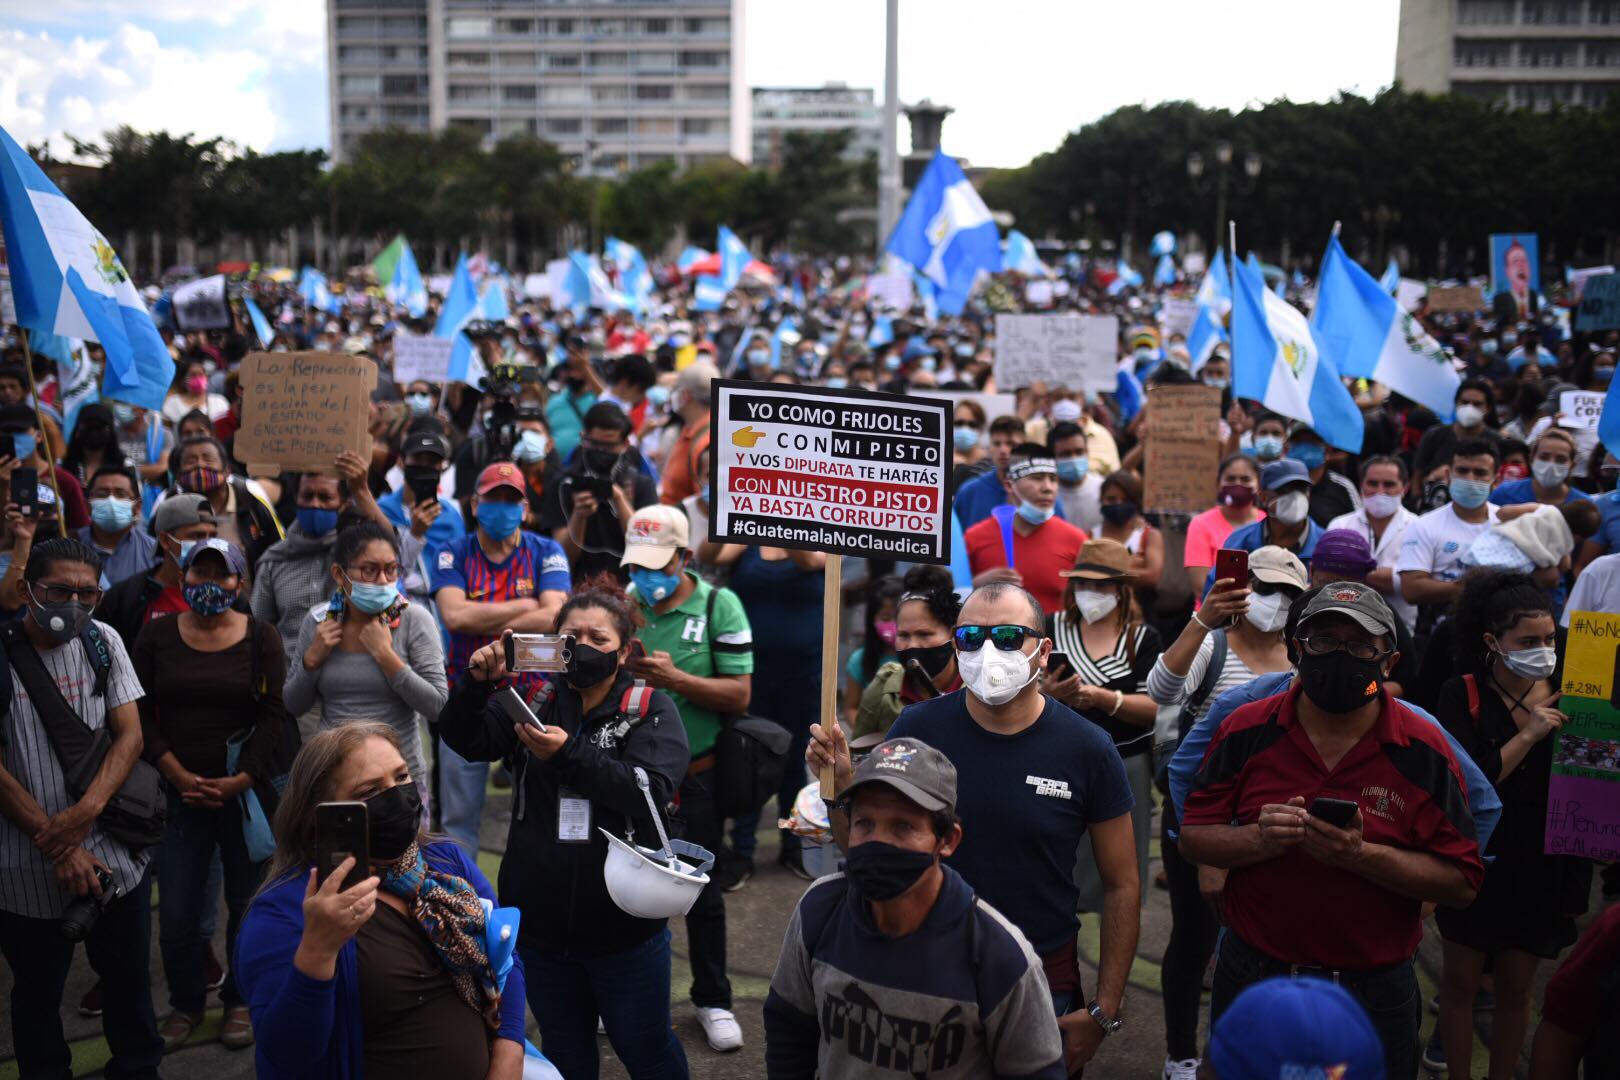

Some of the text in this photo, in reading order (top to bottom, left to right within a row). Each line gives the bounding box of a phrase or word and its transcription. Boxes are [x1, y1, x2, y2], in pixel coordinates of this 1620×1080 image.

[747, 402, 923, 433] YO COMO FRIJOLES
[777, 432, 938, 462] CON MI PISTO
[736, 453, 938, 485] Y VOS DIPURATA TE HARTÁS
[734, 477, 931, 512] CON NUESTRO PISTO
[731, 496, 933, 532] YA BASTA CORRUPTOS
[733, 520, 930, 555] #GuatemalaNoClaudica
[681, 616, 706, 643] H
[1565, 680, 1602, 696] #28N
